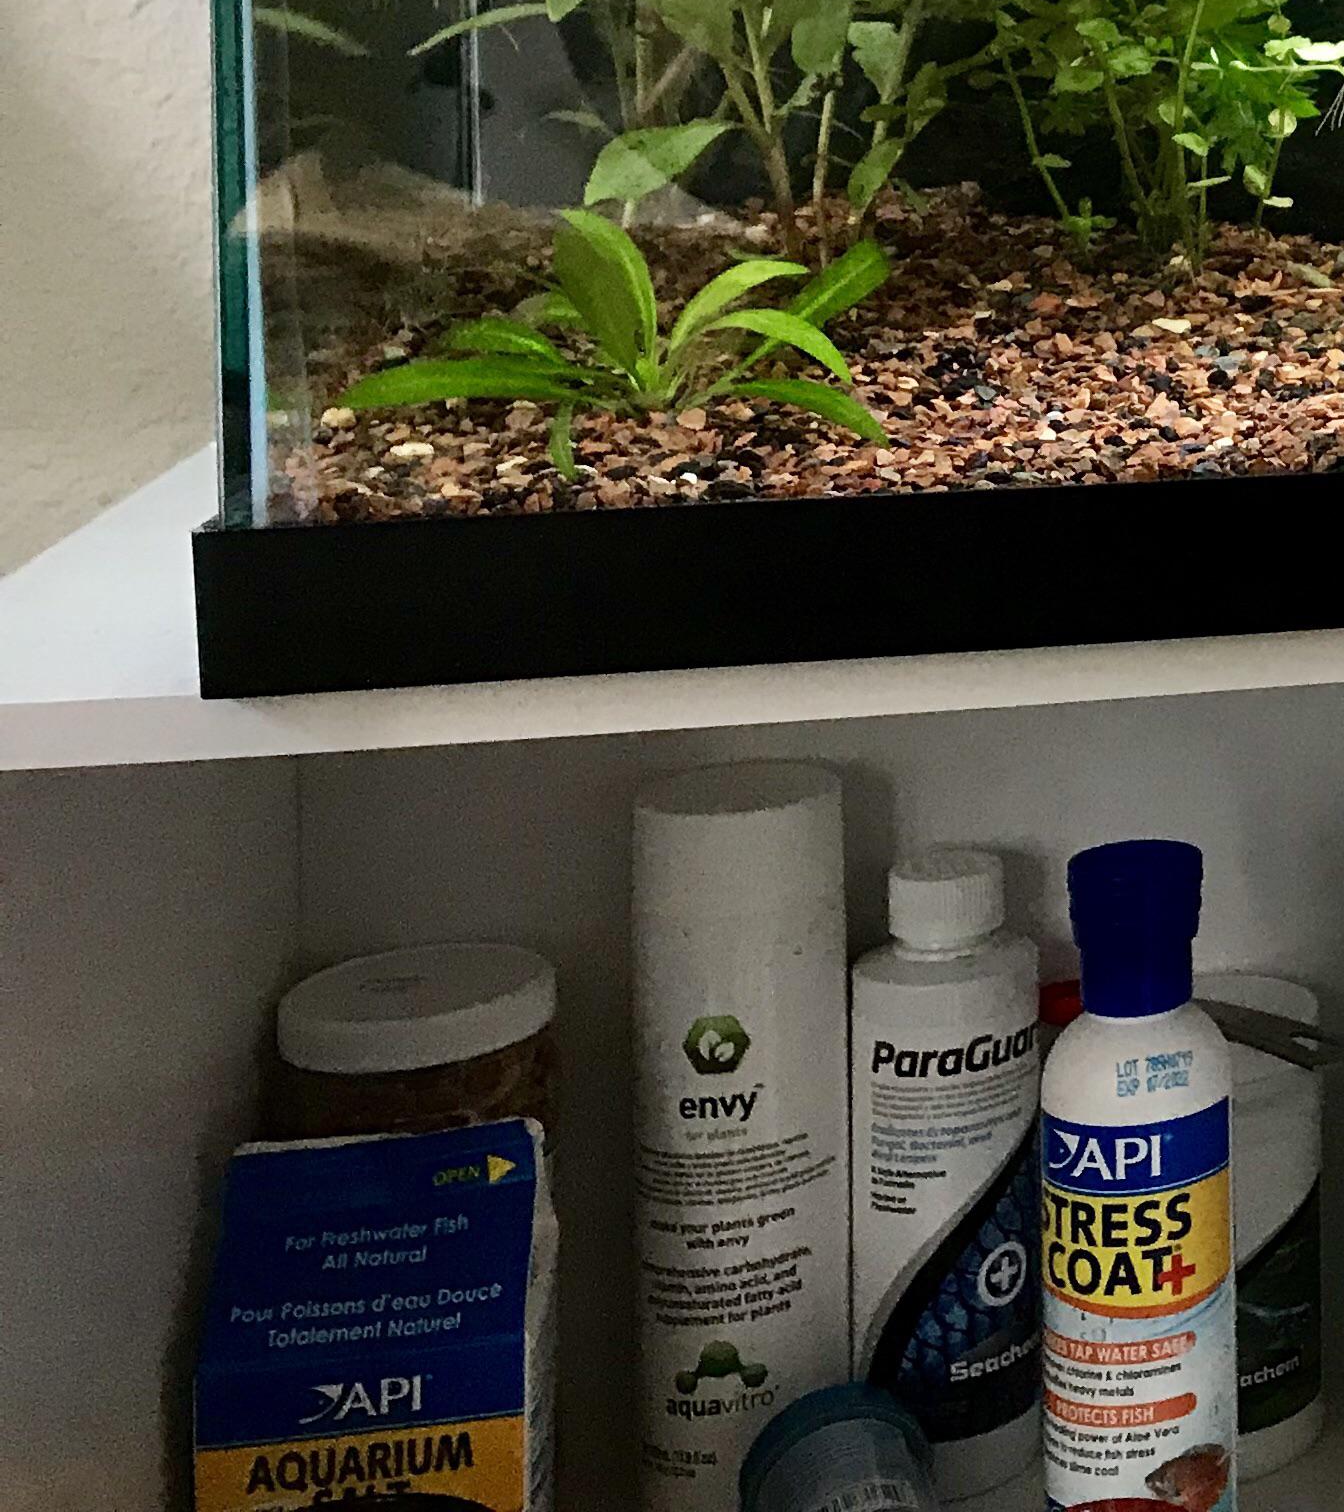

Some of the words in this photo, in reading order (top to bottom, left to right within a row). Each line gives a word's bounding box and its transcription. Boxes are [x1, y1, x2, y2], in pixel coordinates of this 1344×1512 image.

[871, 1022, 1039, 1078] ParaGuar
[1116, 1059, 1139, 1078] LOT
[679, 1091, 758, 1122] envy
[1070, 1134, 1161, 1180] API
[432, 1166, 481, 1186] OPEN
[284, 1235, 316, 1252] For
[320, 1223, 427, 1246] Freshwater
[433, 1213, 469, 1236] Fish
[711, 1218, 754, 1235] plants
[757, 1207, 796, 1228] green
[322, 1254, 347, 1270] All
[355, 1246, 428, 1268] Natural
[773, 1264, 797, 1282] and
[230, 1306, 273, 1323] Pour
[280, 1299, 365, 1320] Poissons
[371, 1292, 430, 1312] d'eau
[437, 1283, 503, 1304] Douce
[751, 1299, 791, 1322] plants
[267, 1320, 382, 1348] Totalement
[387, 1312, 462, 1338] Naturel
[1069, 1343, 1093, 1359] TAP
[1097, 1345, 1147, 1362] WATER
[1240, 1356, 1300, 1387] achem
[333, 1374, 422, 1421] API
[666, 1389, 774, 1421] aquavitro
[1056, 1400, 1118, 1425] PROTECTS
[1122, 1407, 1154, 1424] FISH
[246, 1431, 475, 1495] AQUARIUM
